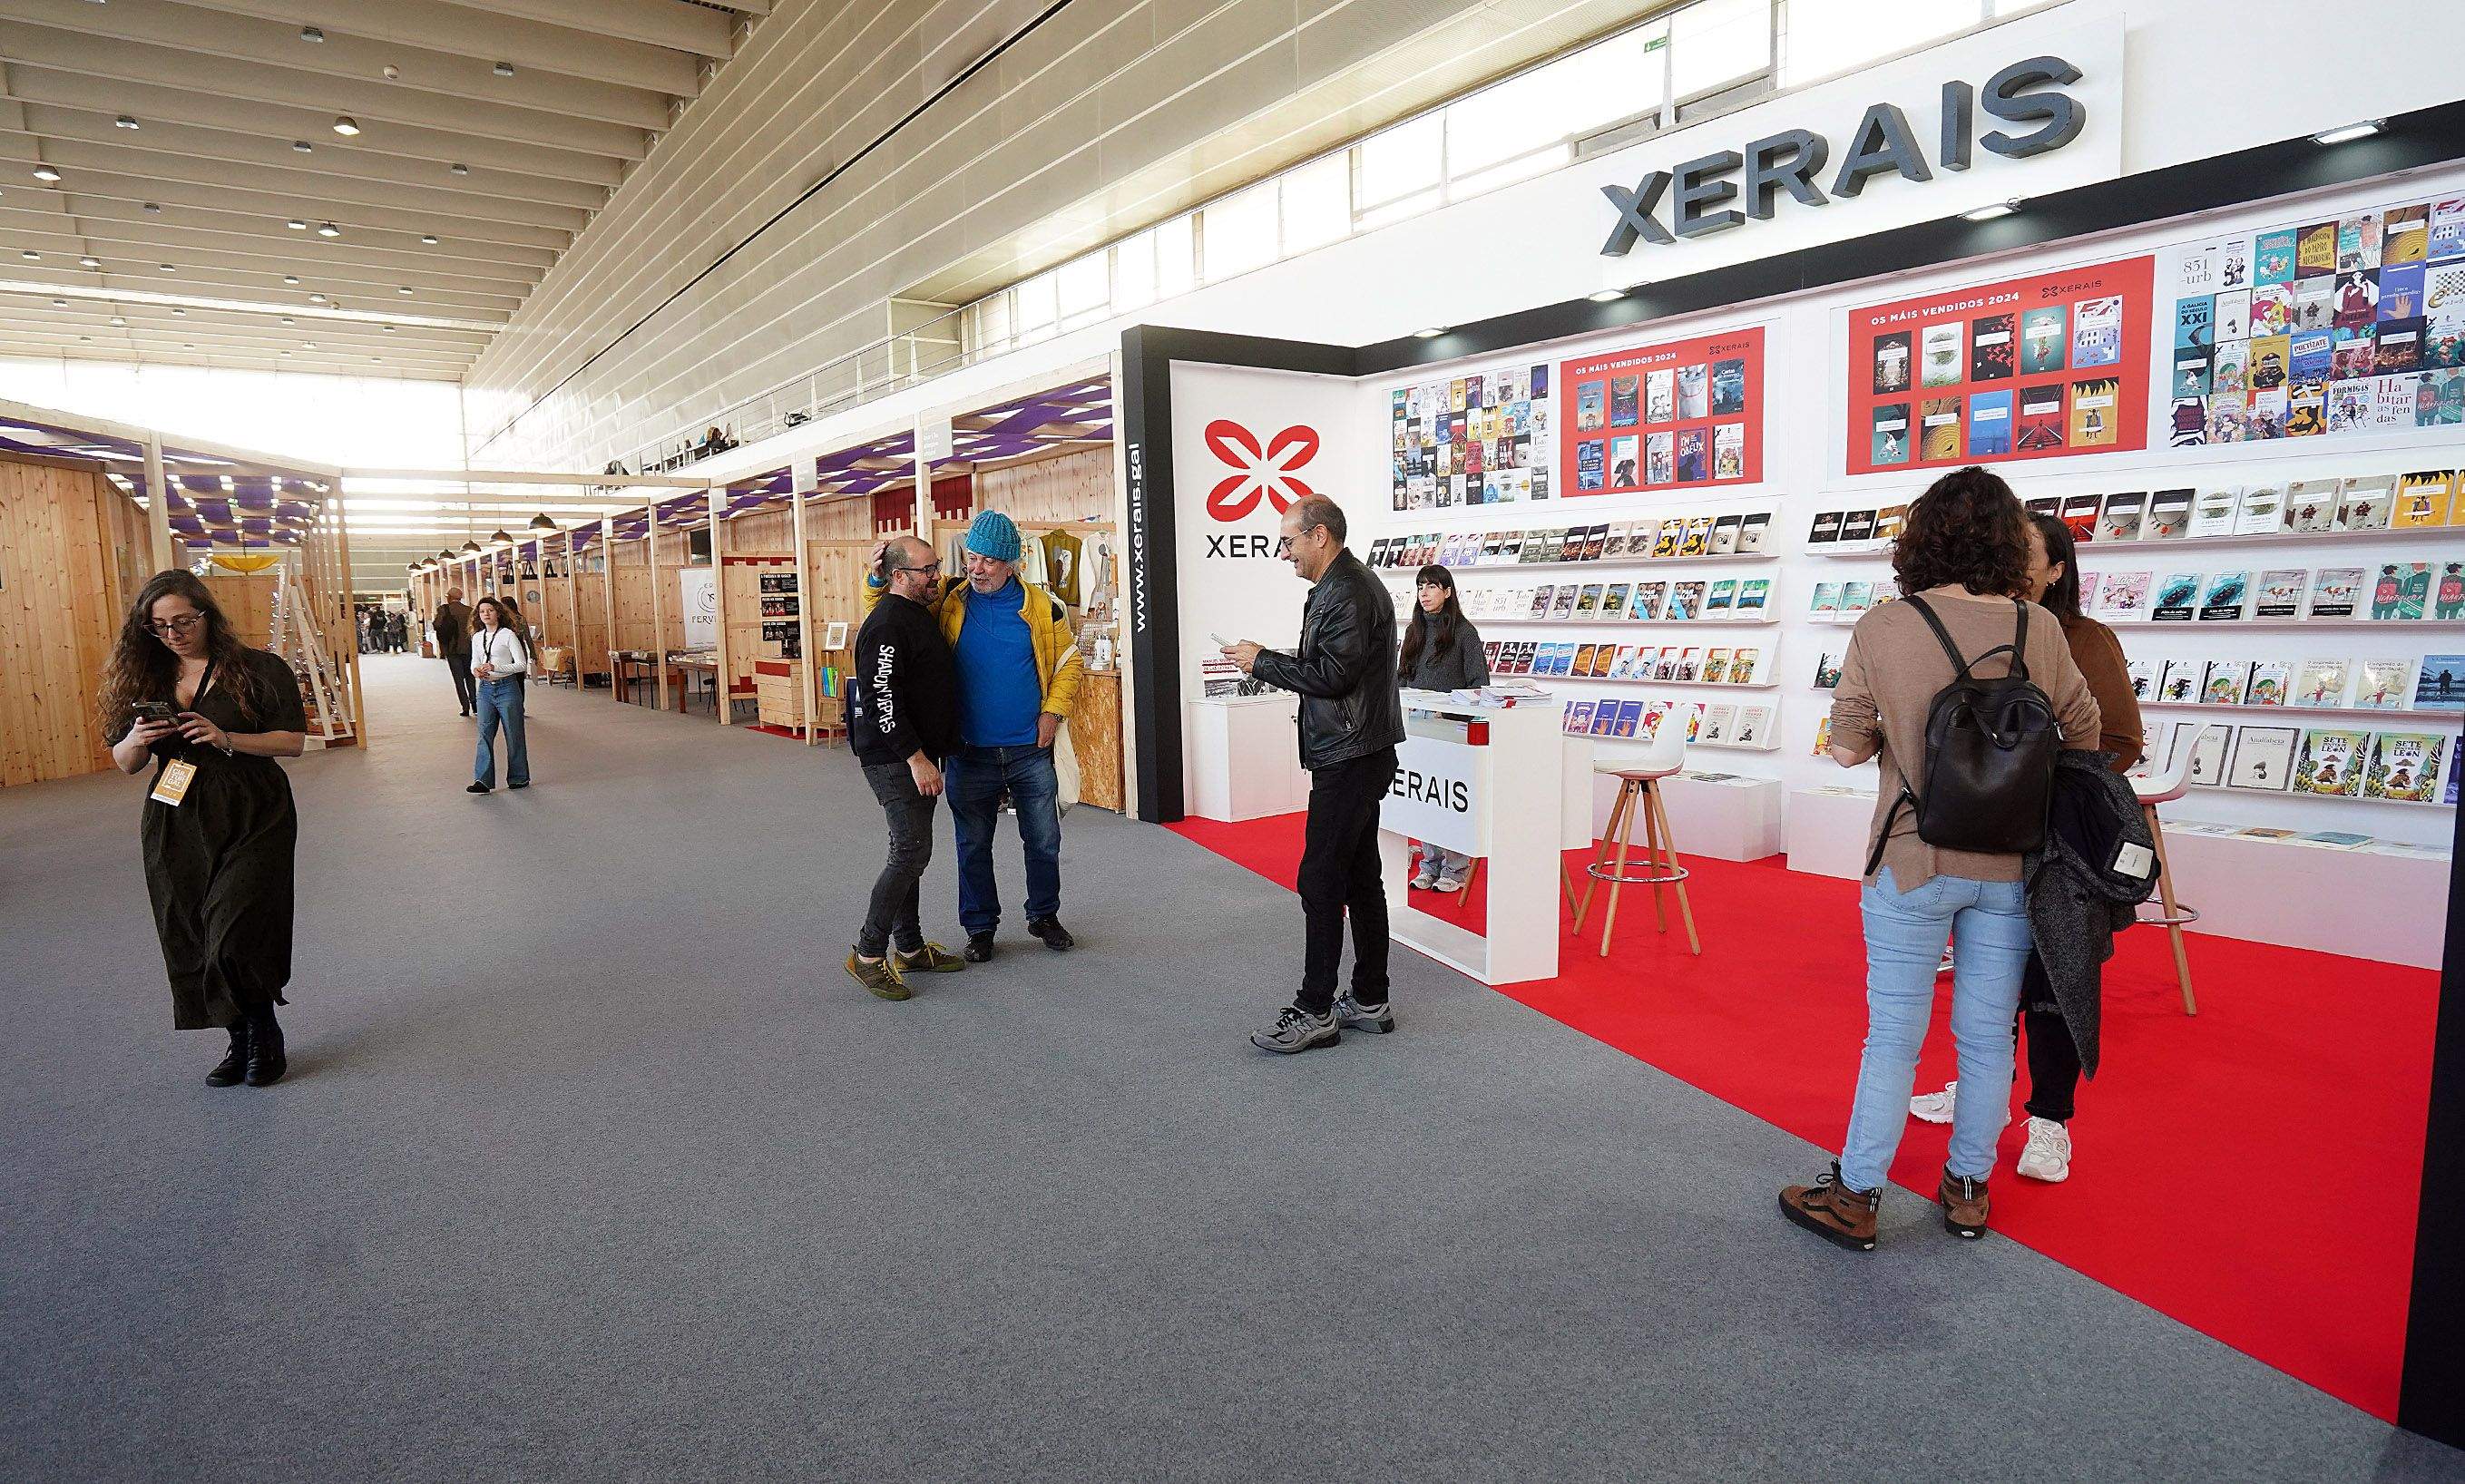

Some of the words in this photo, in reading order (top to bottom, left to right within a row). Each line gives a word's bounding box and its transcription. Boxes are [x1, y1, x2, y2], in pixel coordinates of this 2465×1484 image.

[1600, 55, 2087, 258] XERAIS
[2059, 279, 2102, 294] XERAIS
[1871, 317, 1886, 326] OS
[1890, 309, 1918, 323] MÁIS
[1922, 298, 1984, 317] VENDIDOS
[1988, 291, 2020, 305] 2024
[2180, 312, 2207, 327] XXI
[1720, 341, 1750, 352] XERAIS
[1576, 366, 1586, 376] OS
[1589, 363, 1609, 374] MÁIS
[1610, 356, 1653, 369] VENDIDOS
[1655, 352, 1677, 363] 2024
[2378, 377, 2402, 394] Ha
[2377, 393, 2412, 405] bitar
[2376, 414, 2397, 424] das
[1128, 442, 1147, 633] www.xerais.gal
[1206, 534, 1283, 559] XER
[2323, 736, 2350, 744] SETE
[2395, 740, 2424, 748] SETE
[1387, 768, 1469, 813] ERAIS
